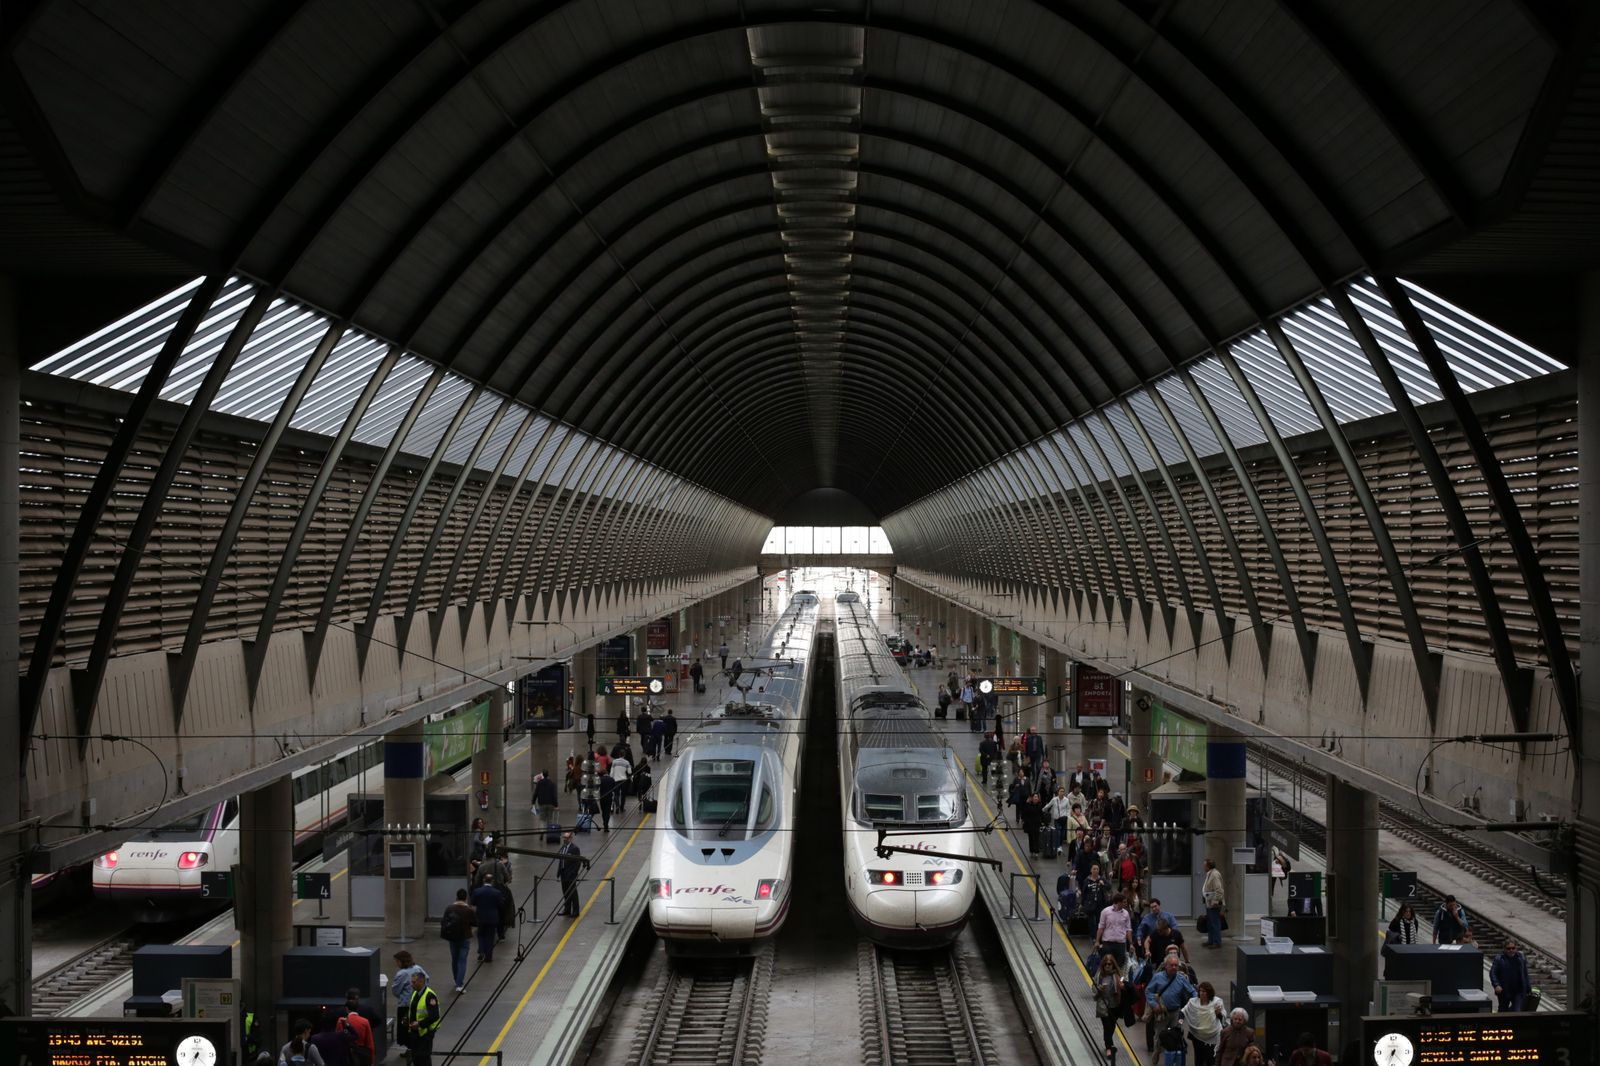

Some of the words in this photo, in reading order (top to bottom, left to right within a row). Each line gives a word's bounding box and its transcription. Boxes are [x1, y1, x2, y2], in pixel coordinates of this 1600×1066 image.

[604, 686, 610, 694] 4
[1032, 686, 1038, 695] 3
[129, 848, 168, 860] renfe
[202, 884, 210, 897] 5
[320, 885, 329, 898] 4
[675, 884, 736, 896] renfe
[1289, 885, 1297, 897] 3
[1408, 884, 1417, 897] 2
[721, 895, 753, 905] AVE
[1457, 1030, 1477, 1042] AVE
[52, 1055, 91, 1066] MADRID
[128, 1055, 167, 1066] ATOCHA
[1420, 1050, 1465, 1063] SEVILLA
[1470, 1049, 1502, 1062] SANTA
[1507, 1048, 1539, 1061] JUSTA
[1555, 1047, 1570, 1066] 3
